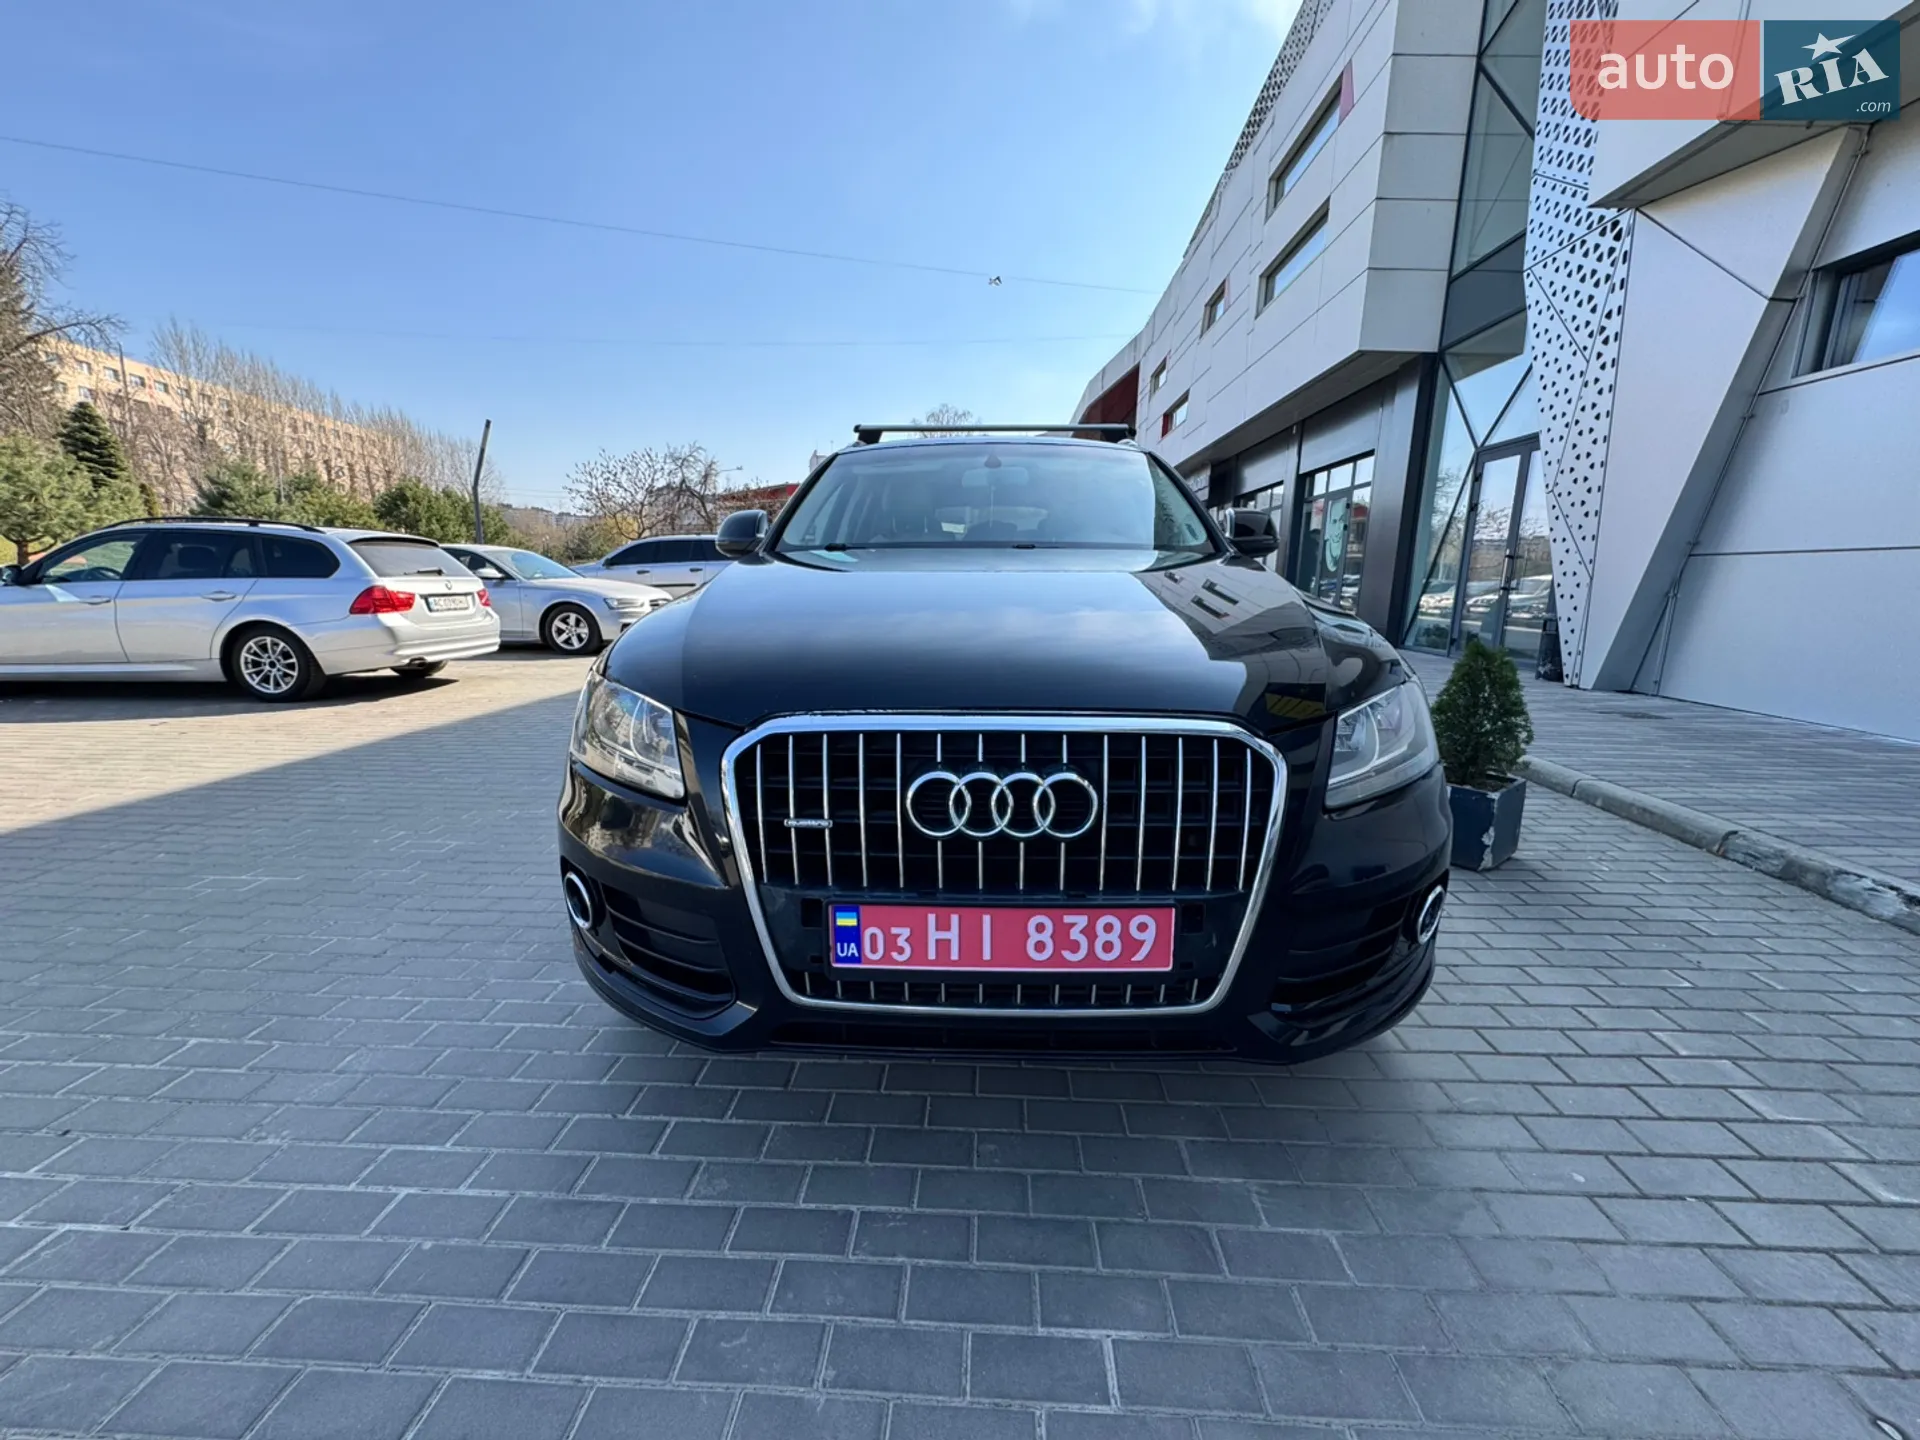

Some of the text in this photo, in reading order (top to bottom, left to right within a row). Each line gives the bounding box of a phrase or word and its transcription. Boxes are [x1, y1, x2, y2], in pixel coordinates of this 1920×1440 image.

[837, 942, 859, 958] UA
[863, 927, 912, 961] 03
[1026, 914, 1157, 962] 8389
